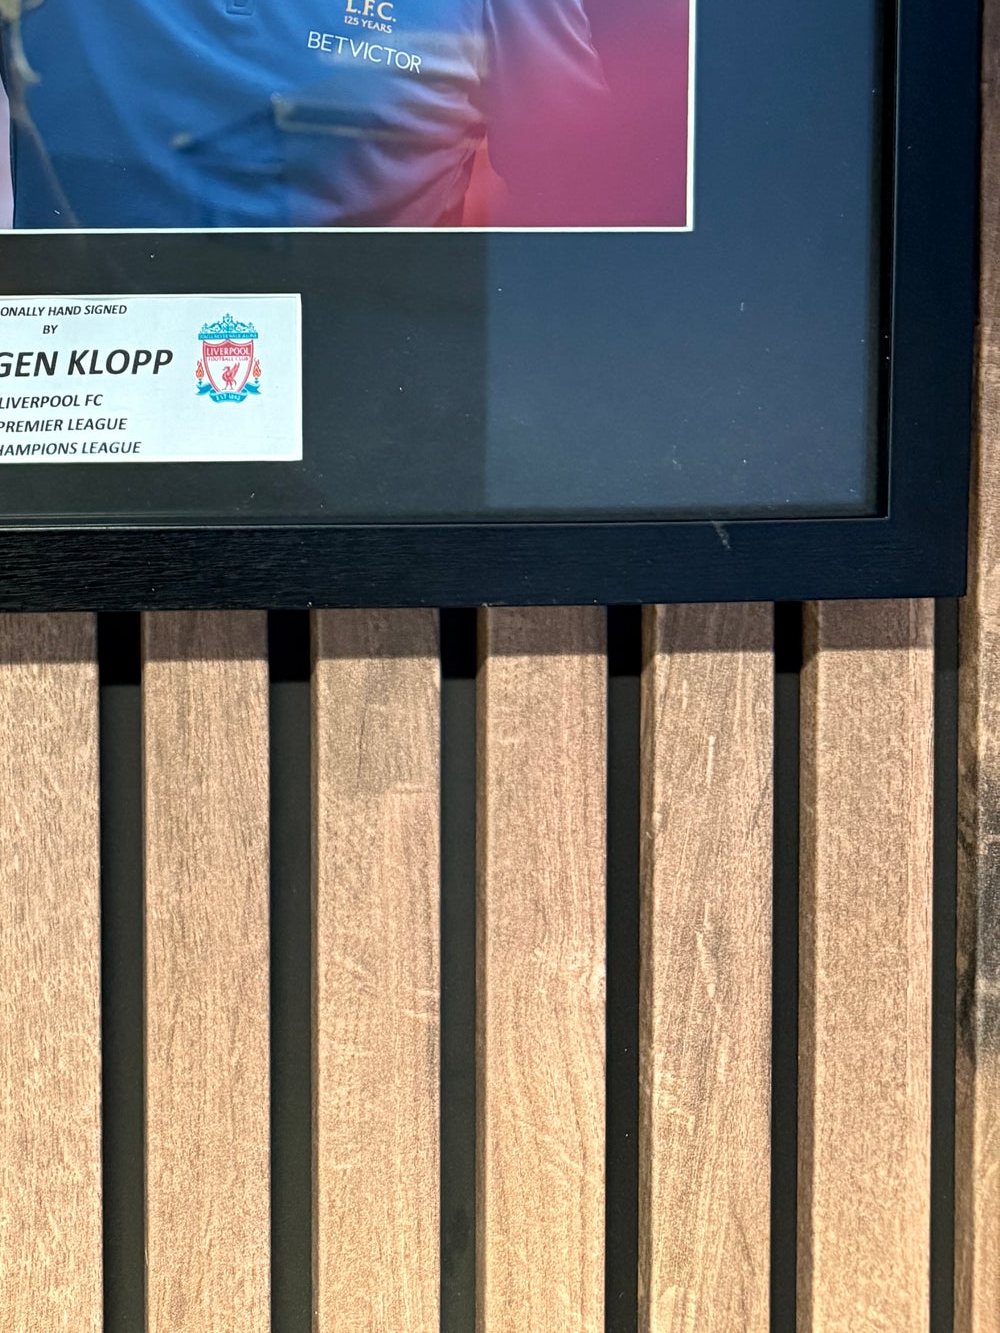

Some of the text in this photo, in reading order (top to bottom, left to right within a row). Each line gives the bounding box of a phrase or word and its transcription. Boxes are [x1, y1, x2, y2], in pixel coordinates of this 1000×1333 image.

[344, 15, 392, 34] 125 YEARS
[307, 31, 422, 74] BETVICTOR
[47, 305, 82, 316] HAND
[83, 304, 128, 315] SIGNED
[42, 324, 58, 335] BY
[206, 347, 251, 356] LIVERPOOL
[67, 348, 174, 376] KLOPP
[85, 394, 104, 407] FC
[67, 417, 128, 431] LEAGUE
[81, 441, 142, 454] LEAGUE
